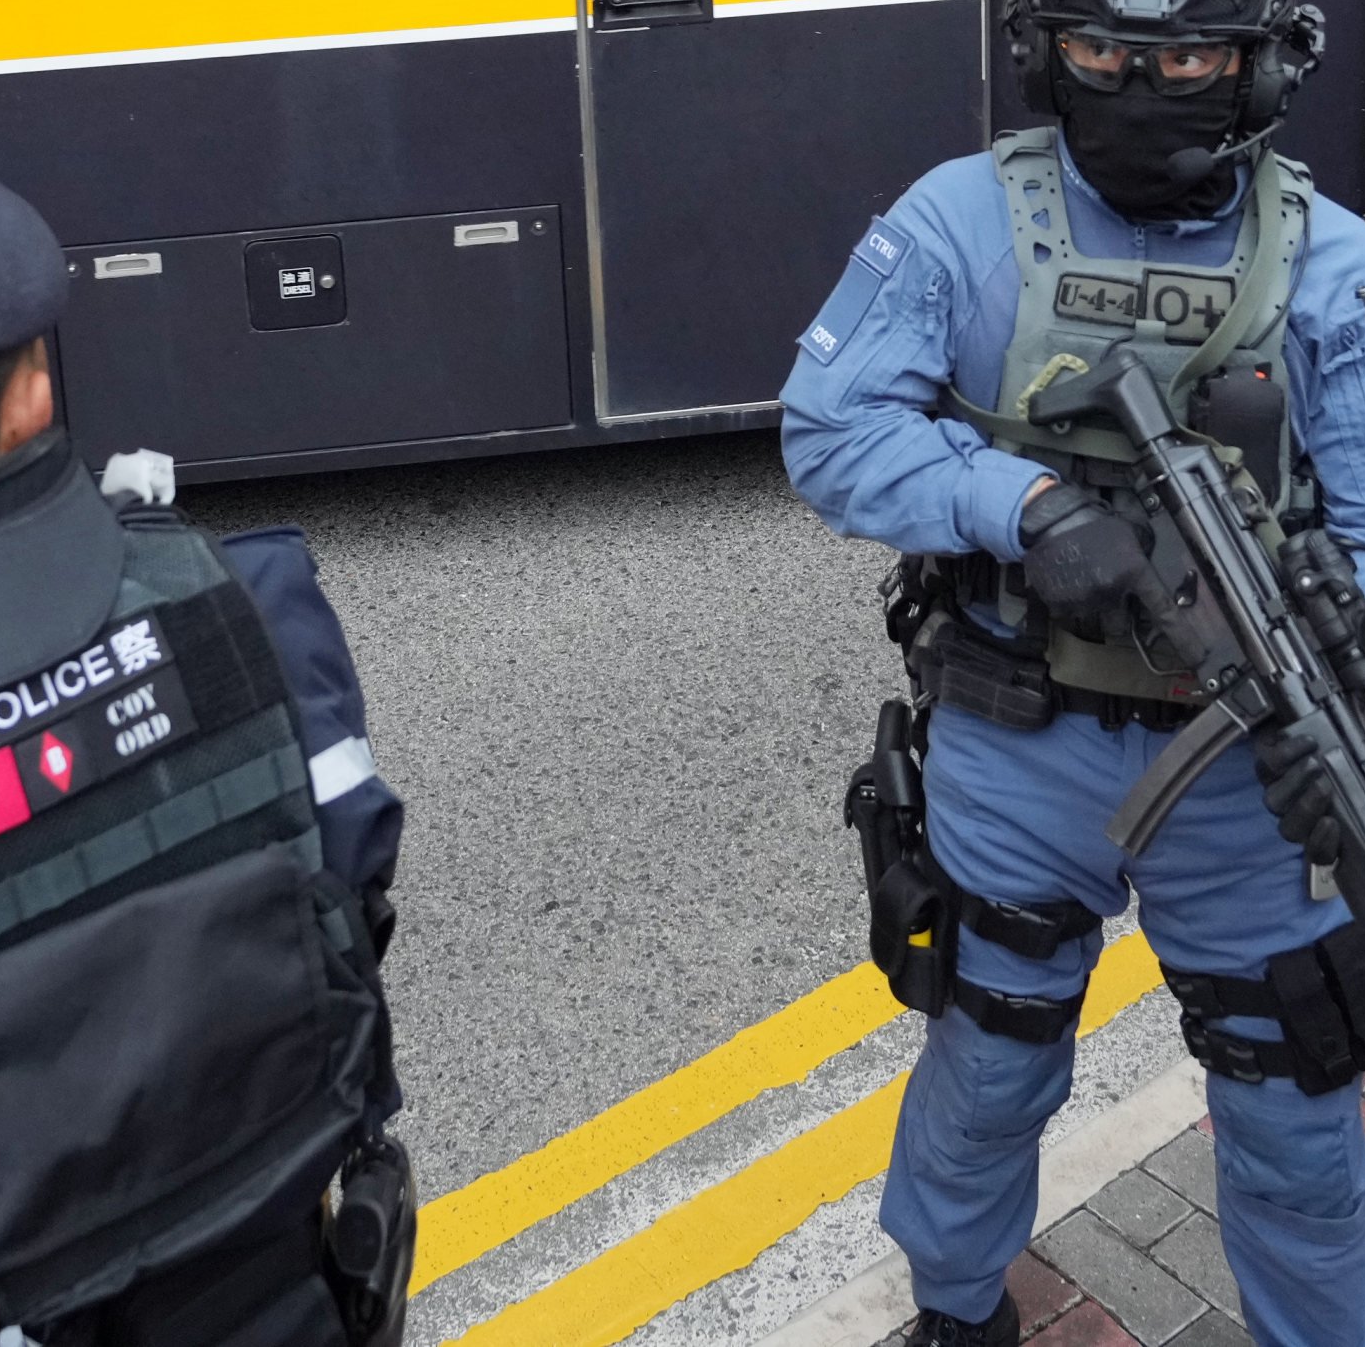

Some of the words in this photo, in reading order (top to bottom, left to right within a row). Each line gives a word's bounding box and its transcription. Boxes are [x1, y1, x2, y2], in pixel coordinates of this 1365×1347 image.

[869, 233, 898, 260] CTRU
[283, 284, 313, 295] DIESEL
[110, 619, 162, 676] 察
[106, 683, 156, 727] COY
